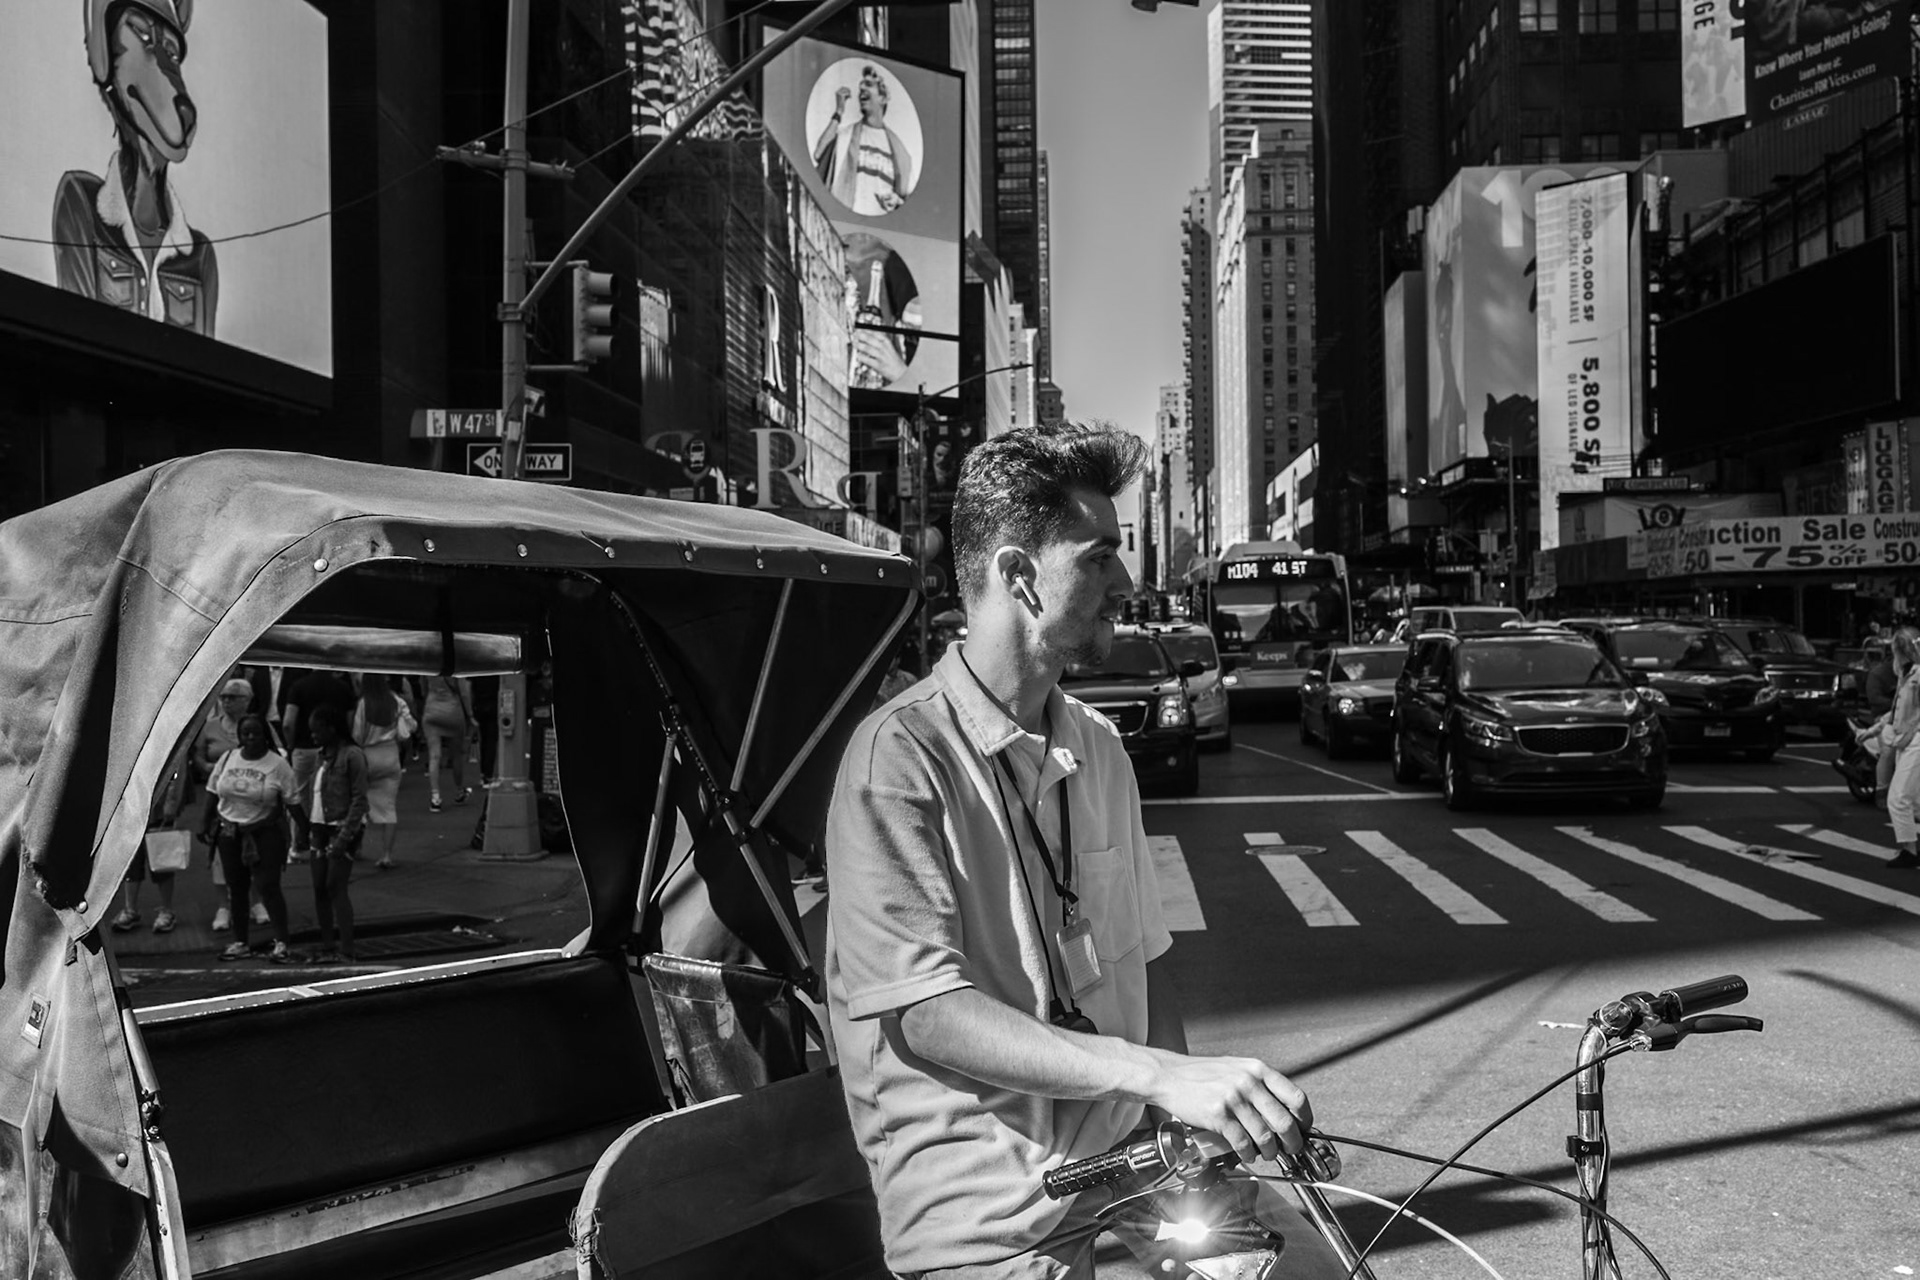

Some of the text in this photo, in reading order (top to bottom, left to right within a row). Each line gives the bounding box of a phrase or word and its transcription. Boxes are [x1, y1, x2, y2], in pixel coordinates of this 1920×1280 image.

[1755, 60, 1777, 79] Know
[1778, 50, 1803, 70] Where
[1804, 41, 1823, 58] Your
[1824, 30, 1851, 52] Money
[1861, 10, 1892, 39] Going?
[1816, 60, 1832, 75] More
[1568, 199, 1580, 324] RETAIL SPACE AVAILABLE
[1583, 304, 1594, 322] SF
[1580, 356, 1601, 432] 5,800
[449, 413, 496, 434] W 47 St
[1567, 373, 1578, 453] OF LED SIGNAGE
[526, 455, 557, 469] WAY
[749, 427, 829, 510] R
[1803, 518, 1866, 541] Sale
[1227, 561, 1308, 580] M104 41 ST
[1829, 555, 1867, 565] OFF
[1256, 651, 1288, 662] Keeps
